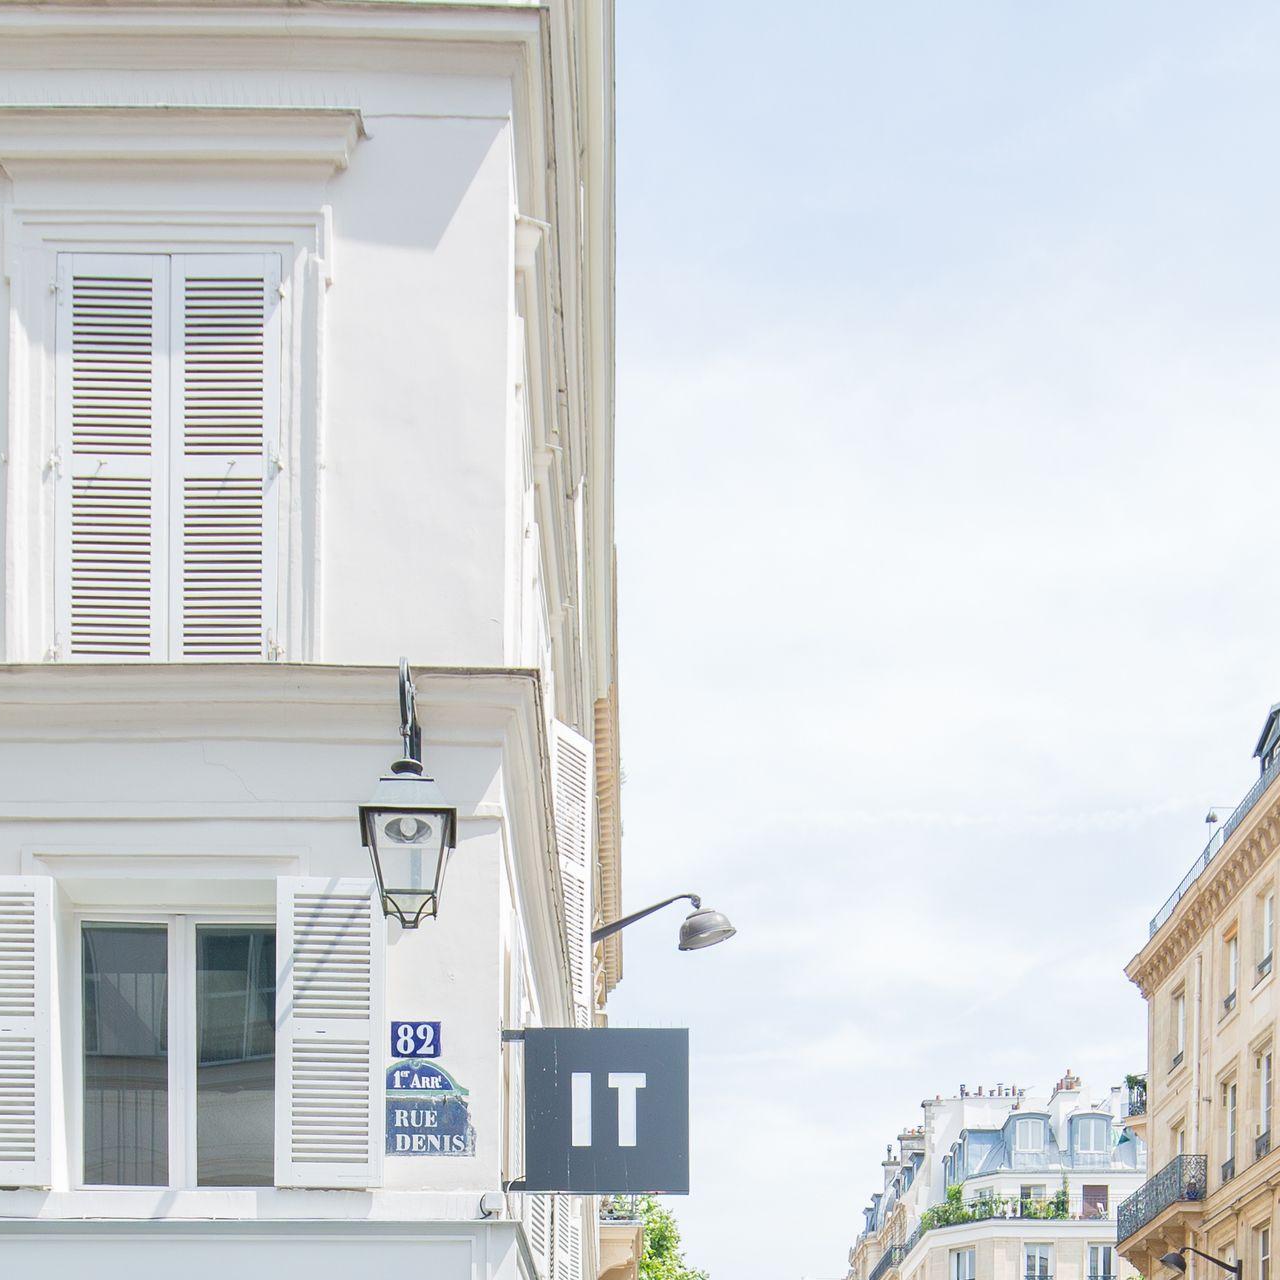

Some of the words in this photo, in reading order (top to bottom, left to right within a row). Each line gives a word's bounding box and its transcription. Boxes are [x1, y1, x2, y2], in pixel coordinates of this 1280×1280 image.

[396, 1024, 434, 1055] 82
[394, 1109, 437, 1127] RUE
[571, 1072, 646, 1146] IT
[396, 1134, 465, 1152] DENIS
